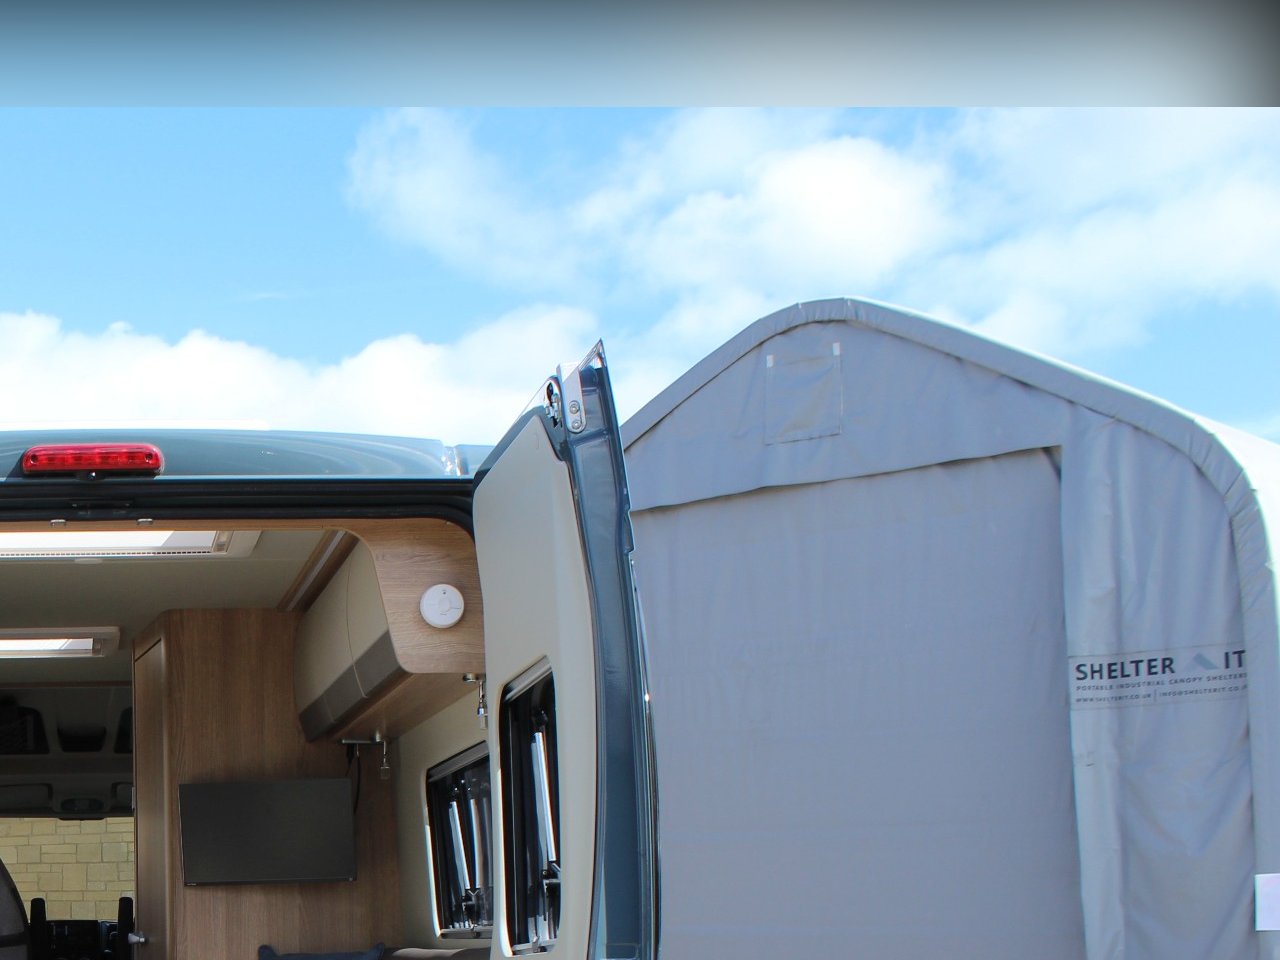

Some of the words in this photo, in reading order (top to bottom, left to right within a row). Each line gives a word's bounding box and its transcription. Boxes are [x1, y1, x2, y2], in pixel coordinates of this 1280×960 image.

[1075, 657, 1176, 681] SHELTER
[1224, 649, 1246, 669] IT
[1076, 683, 1113, 692] PORTABLE
[1115, 680, 1165, 690] INDUSTRIAL
[1168, 676, 1203, 686] CANOPY
